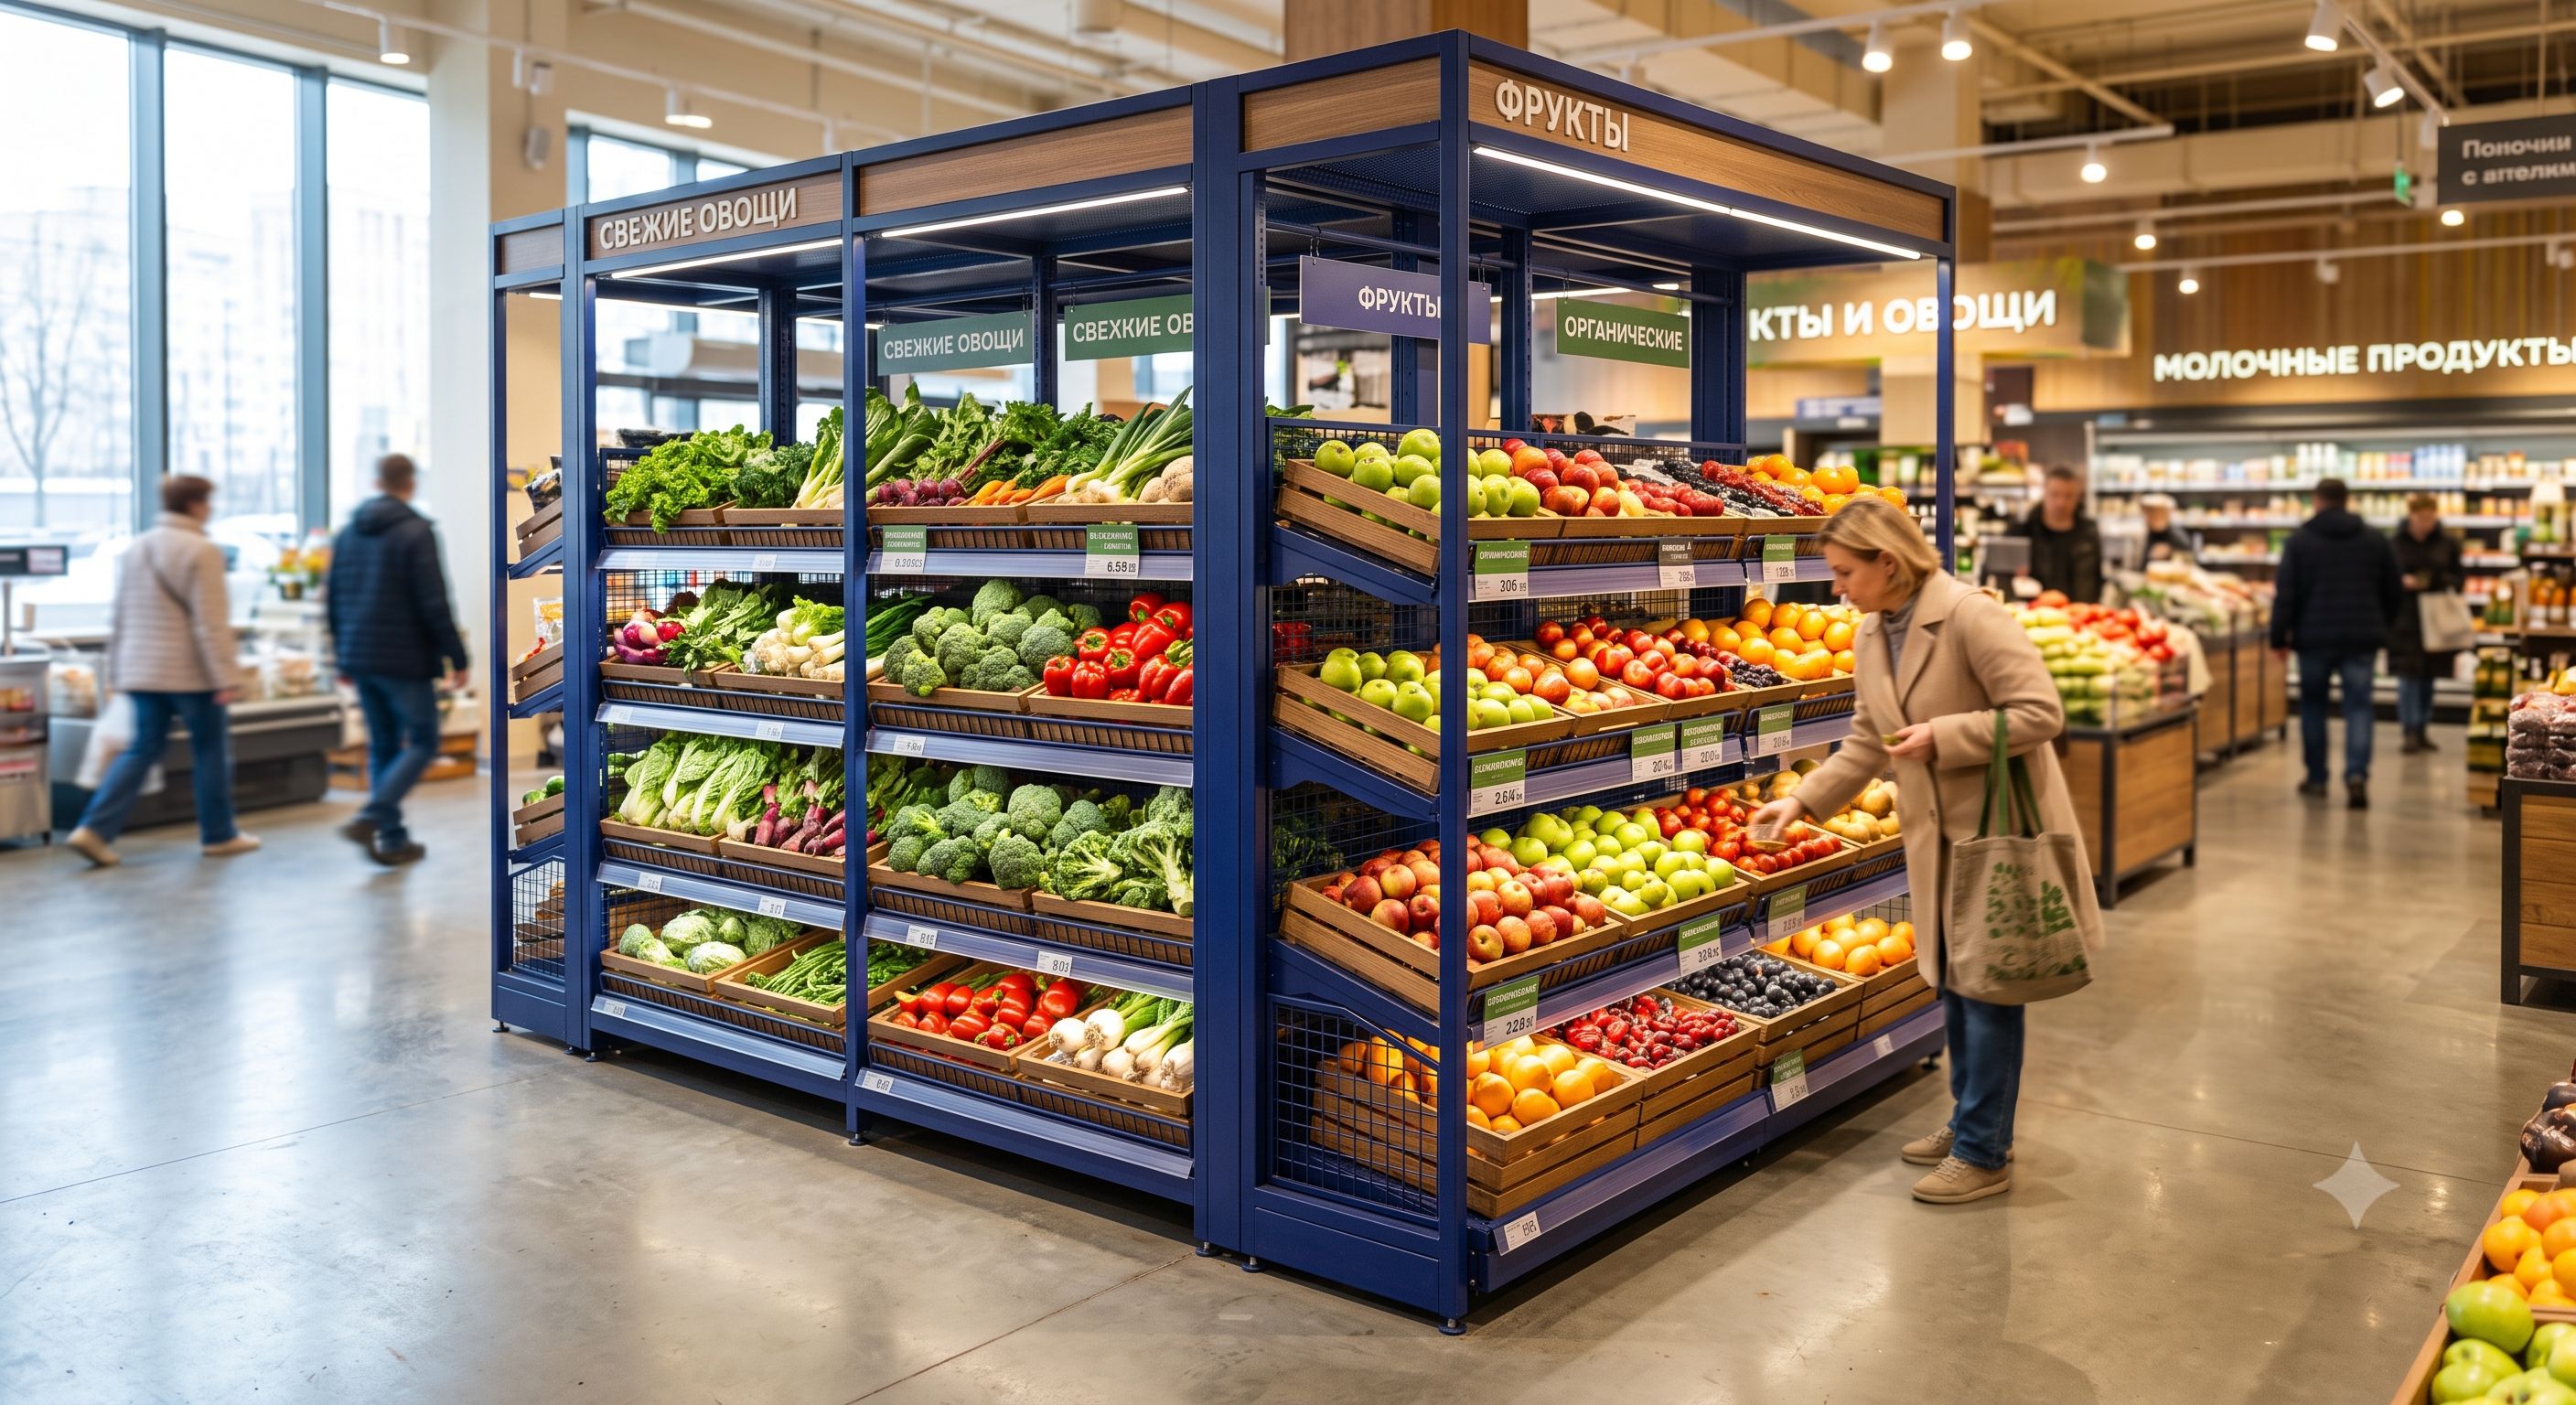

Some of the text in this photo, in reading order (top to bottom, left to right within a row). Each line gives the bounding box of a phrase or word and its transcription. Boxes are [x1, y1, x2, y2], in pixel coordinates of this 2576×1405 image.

[1496, 79, 1628, 152] ФРУКТЫ
[600, 188, 797, 250] СВЕЖИЕ ОВОЩИ
[1358, 285, 1441, 318] ФРУКТЫ
[1843, 301, 1873, 336] И
[1883, 289, 2055, 335] ОВОЩИ
[958, 327, 1024, 353] ОВОЩИ
[1565, 316, 1683, 351] ОРГАНИЧЕСКИЕ
[2153, 336, 2576, 382] МОЛОЧНЫЕ ПРОДУКТЫ
